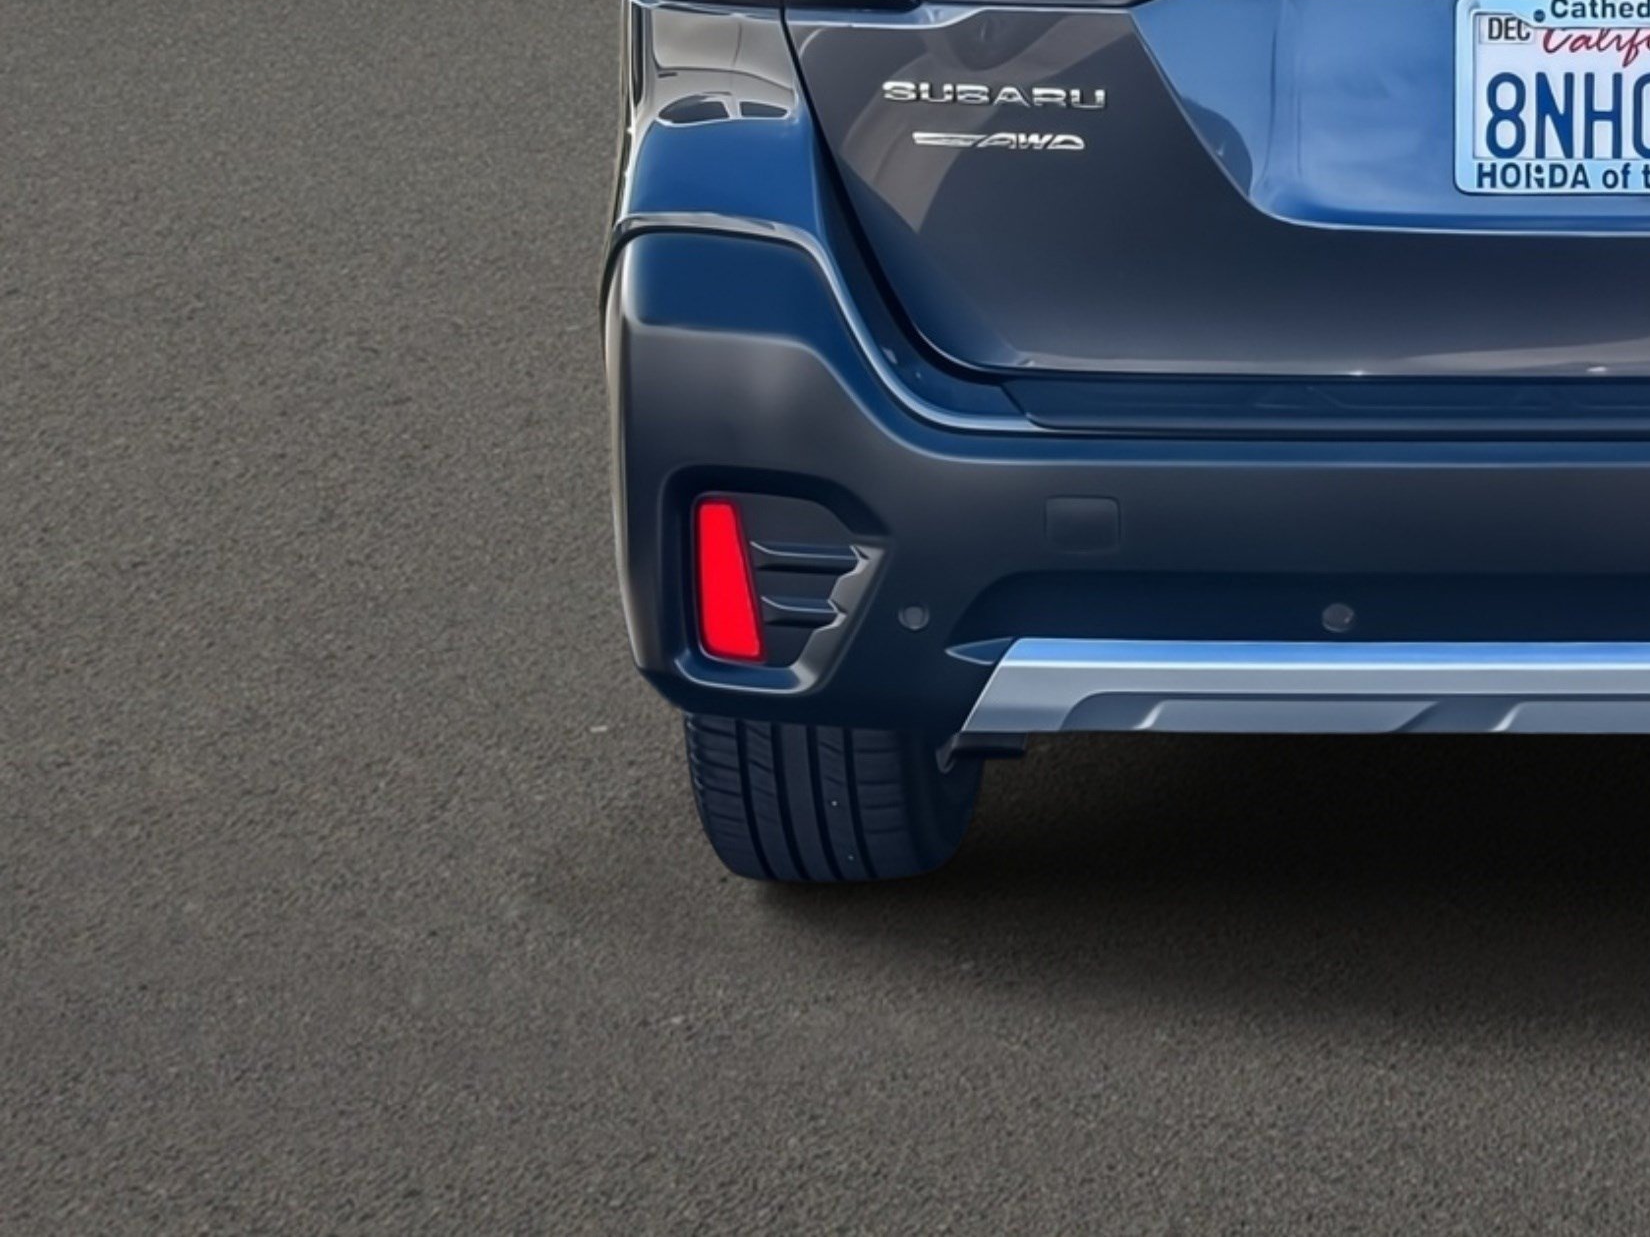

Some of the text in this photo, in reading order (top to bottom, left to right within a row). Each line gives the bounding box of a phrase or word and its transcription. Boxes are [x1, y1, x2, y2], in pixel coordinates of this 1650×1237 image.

[1488, 17, 1530, 40] DEC
[882, 81, 1106, 109] SUBARU
[976, 132, 1085, 150] AWD
[1477, 163, 1590, 189] HONDA
[1602, 163, 1630, 189] of
